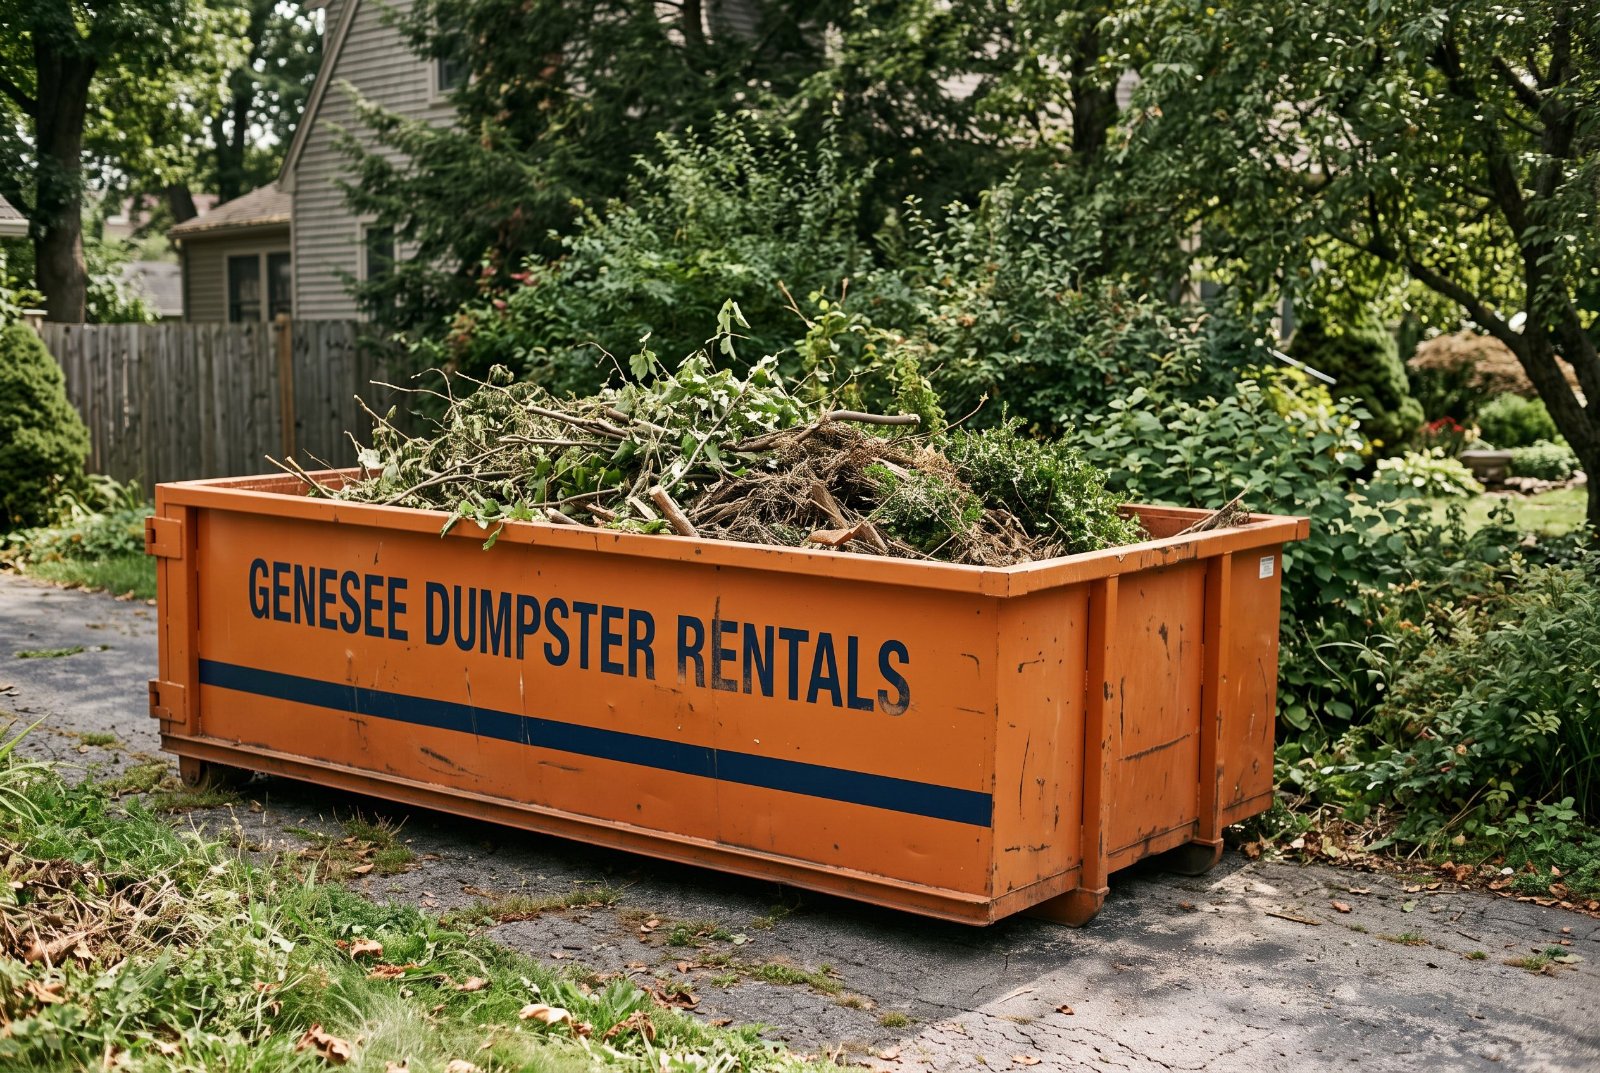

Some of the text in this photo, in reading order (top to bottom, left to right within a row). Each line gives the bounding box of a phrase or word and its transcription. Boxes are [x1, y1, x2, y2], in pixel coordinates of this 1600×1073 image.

[249, 558, 911, 717] GENESEE DUMPSTER RENTALS
